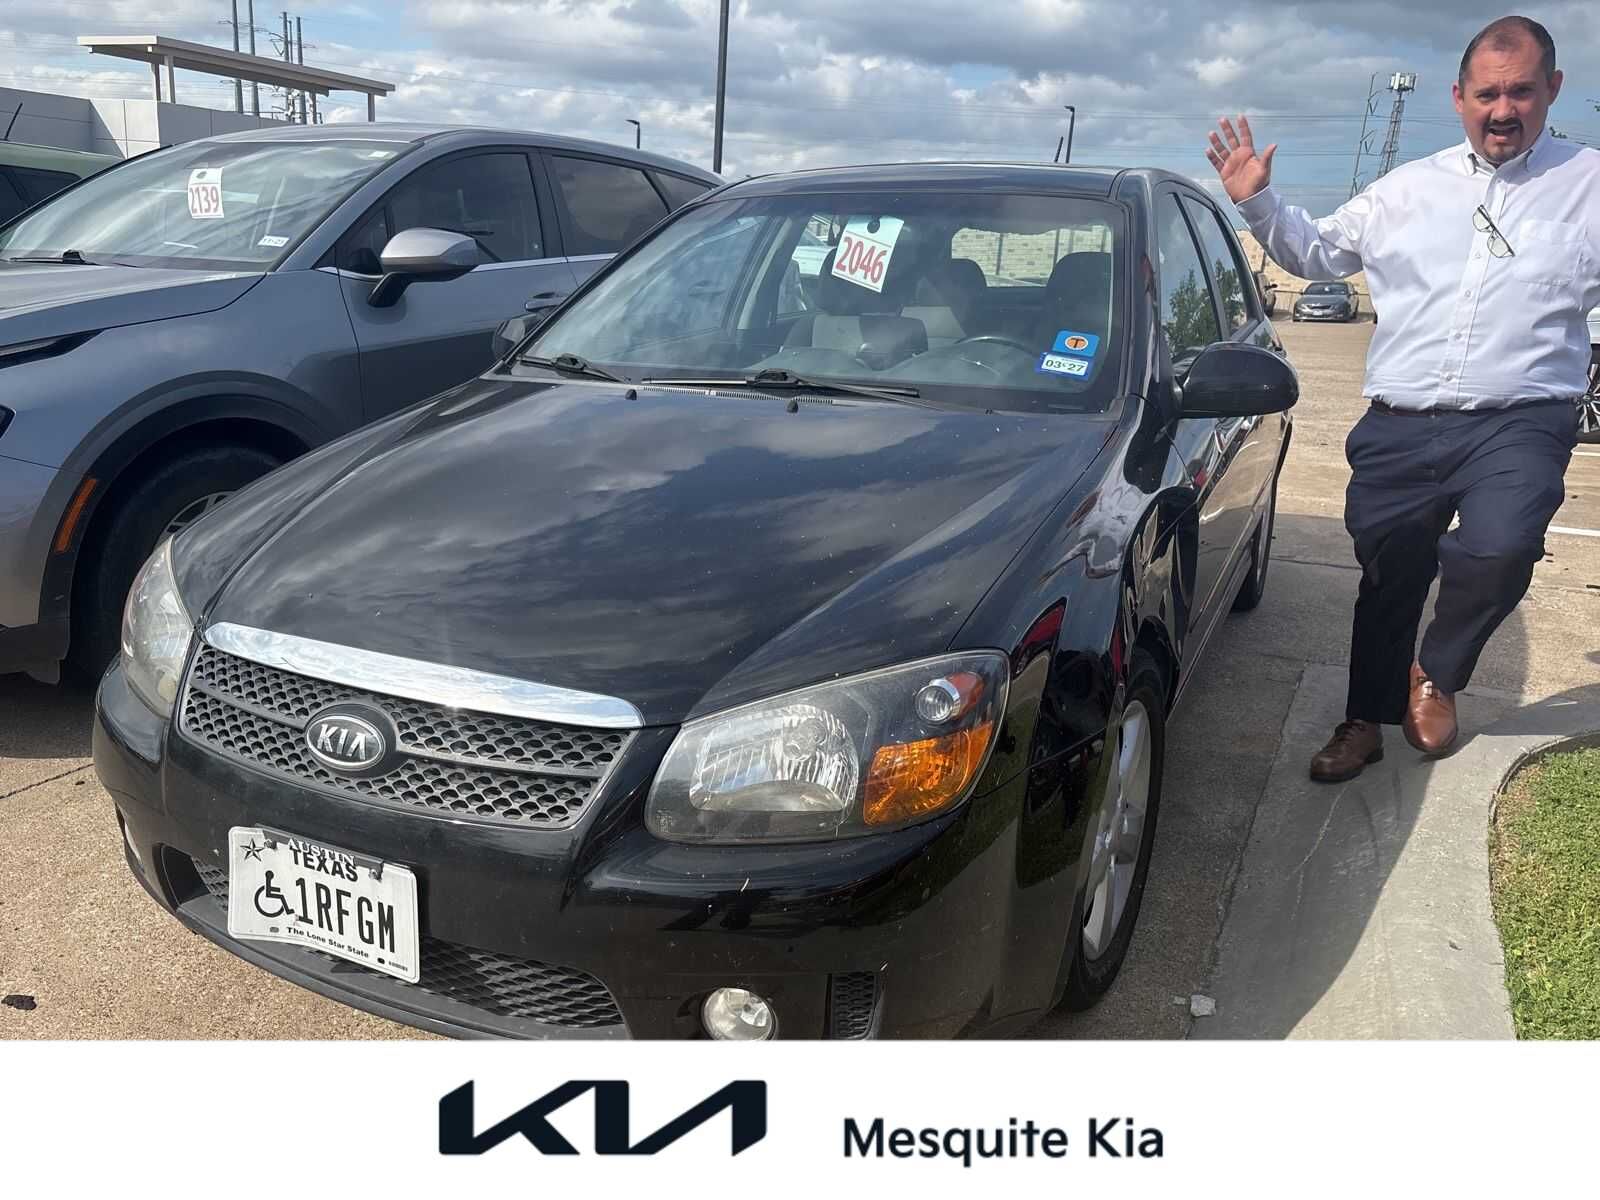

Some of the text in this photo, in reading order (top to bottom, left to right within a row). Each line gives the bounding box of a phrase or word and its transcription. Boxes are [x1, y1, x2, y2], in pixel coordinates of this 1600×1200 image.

[189, 186, 220, 214] 2139
[835, 236, 888, 284] 2046
[317, 723, 367, 761] KIA
[289, 846, 359, 883] TEXAS
[295, 877, 396, 954] 1RFGM
[286, 926, 370, 959] The Lone Star State
